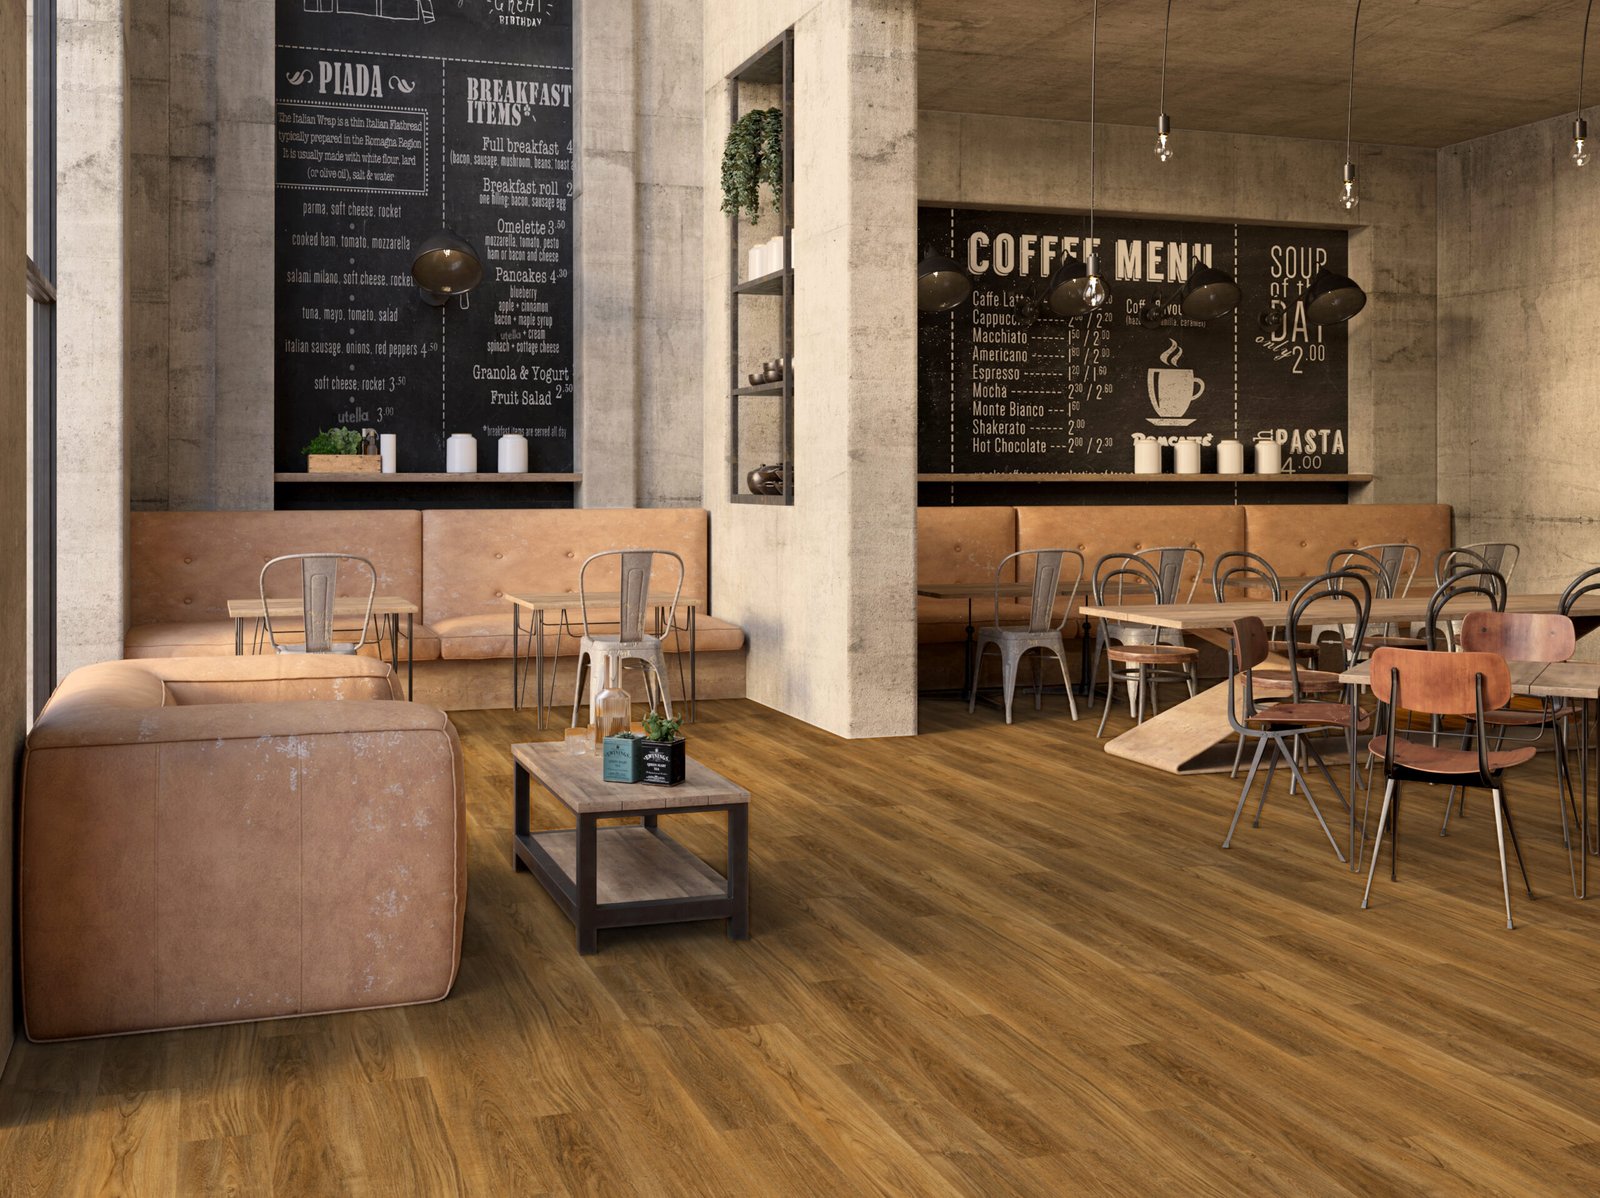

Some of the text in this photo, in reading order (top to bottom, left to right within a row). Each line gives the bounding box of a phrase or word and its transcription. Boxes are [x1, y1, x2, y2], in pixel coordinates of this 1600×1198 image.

[498, 16, 542, 27] BIRTHDAY
[319, 60, 383, 98] PIADA
[467, 77, 572, 107] BREAKFAST
[279, 112, 292, 123] The
[293, 114, 316, 124] Italian
[317, 114, 336, 128] Wrap
[337, 117, 344, 125] is
[350, 117, 364, 128] thin
[366, 118, 388, 129] Italian
[390, 120, 422, 131] Flatbread
[279, 131, 422, 150] typically prepared in the Romagna Region
[482, 136, 504, 152] Full
[507, 138, 560, 155] breakfast
[283, 148, 289, 158] It
[290, 149, 296, 158] is
[297, 150, 323, 162] usually
[325, 151, 344, 161] made
[345, 152, 361, 162] with
[362, 153, 381, 163] white
[402, 155, 416, 165] lard
[307, 167, 318, 179] (or
[320, 168, 336, 178] olive
[353, 170, 365, 180] salt
[367, 170, 373, 180] &
[374, 172, 394, 181] water
[483, 178, 536, 194] Breakfast
[540, 181, 558, 195] roll
[331, 203, 346, 215] soft
[378, 204, 401, 218] rocket
[480, 194, 489, 204] one
[532, 197, 554, 210] sausage
[556, 198, 566, 211] egg
[497, 218, 546, 234] Omelette
[292, 232, 318, 246] cooked
[372, 236, 410, 250] mozzarella
[544, 238, 559, 252] pesto
[487, 247, 558, 262] ham or bacon and cheese
[287, 269, 312, 283] salami
[344, 270, 358, 285] soft
[496, 267, 546, 283] Pancakes
[510, 285, 537, 300] blueberry
[499, 299, 548, 313] apple cinnamon
[379, 308, 398, 322] salad
[494, 312, 552, 328] bacon maple syrup
[528, 329, 545, 339] cream
[972, 328, 1028, 344] Macchiato
[285, 339, 308, 353] italian
[375, 340, 387, 355] red
[389, 344, 418, 357] peppers
[487, 340, 560, 355] spinach cottage cheese
[972, 346, 1028, 362] Americano
[1255, 336, 1292, 360] only
[1292, 344, 1325, 373] 2.00
[473, 365, 569, 384] Granola & Yogurt
[972, 364, 1020, 382] Espresso
[315, 376, 329, 390] soft
[362, 377, 385, 391] rocket
[972, 382, 1007, 398] Mocha
[491, 390, 519, 405] Fruit
[522, 390, 552, 405] Salad
[972, 401, 1005, 417] Monte
[1010, 402, 1044, 417] Bianco
[972, 419, 1026, 435] Shakerato
[973, 438, 990, 453] Hot
[995, 438, 1046, 453] Chocolate
[1276, 429, 1344, 454] PASTA
